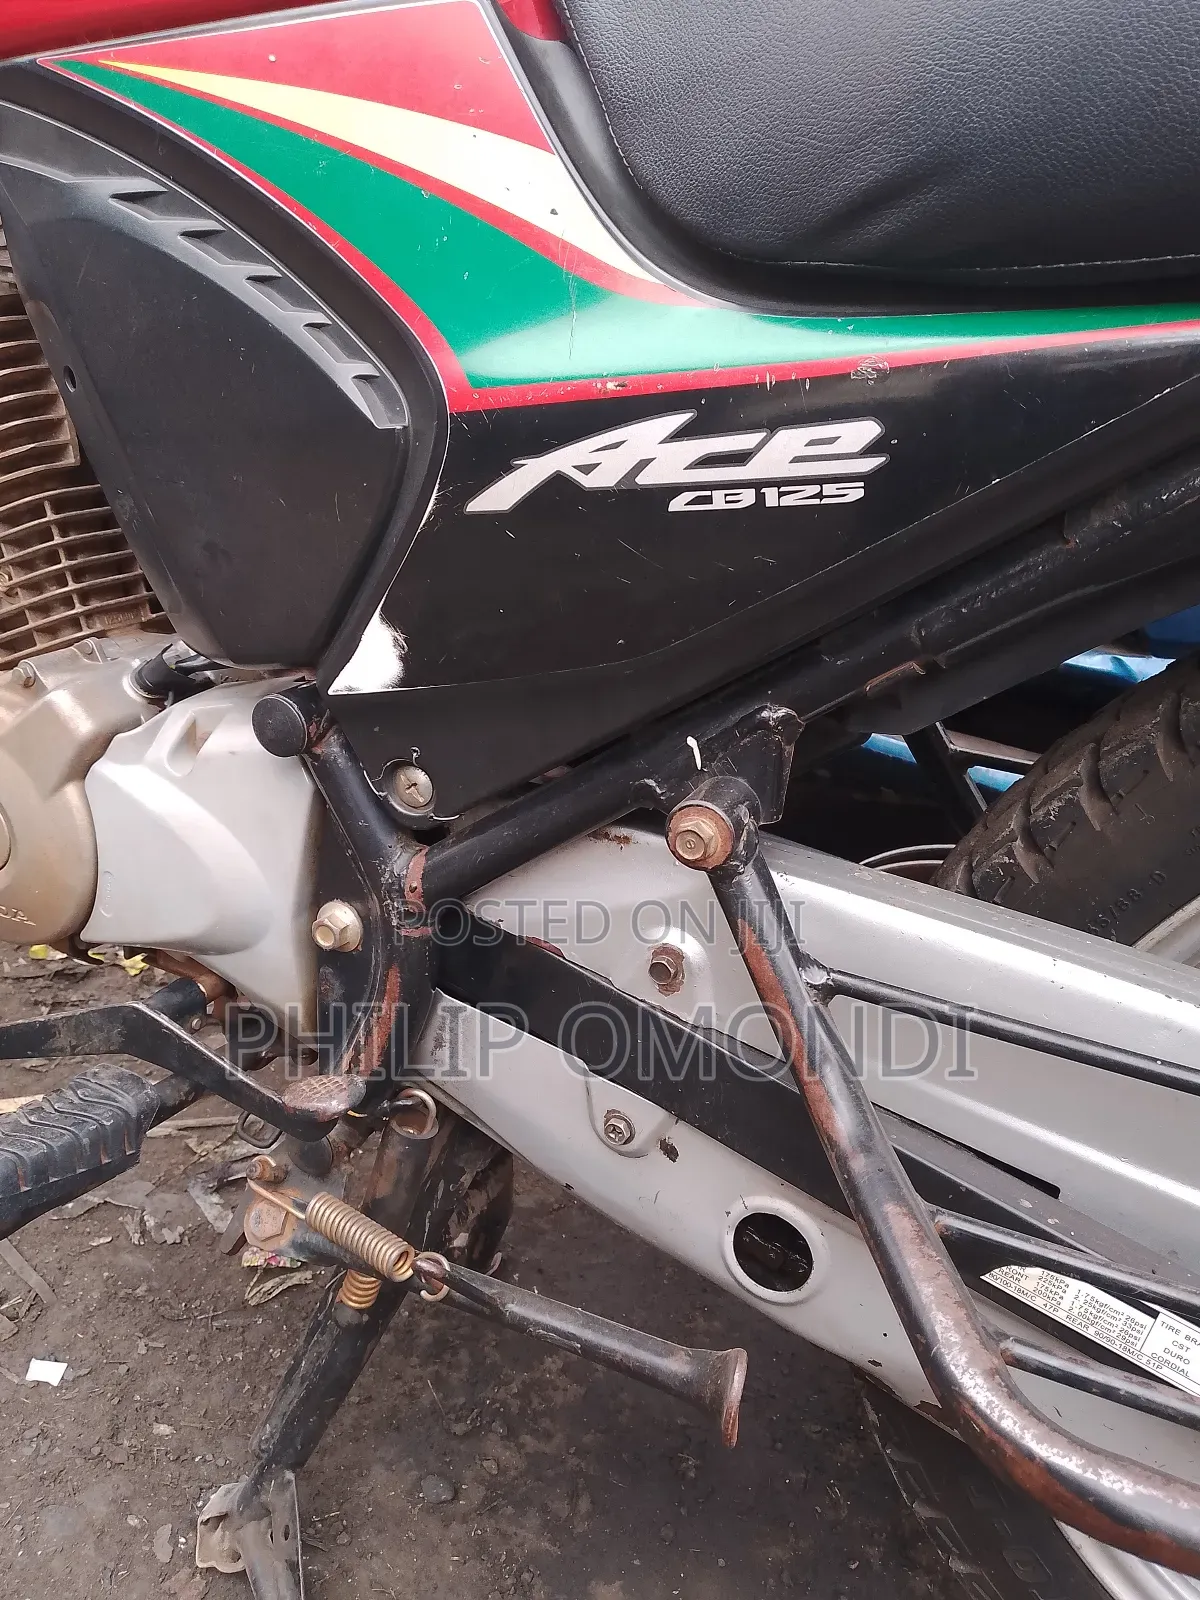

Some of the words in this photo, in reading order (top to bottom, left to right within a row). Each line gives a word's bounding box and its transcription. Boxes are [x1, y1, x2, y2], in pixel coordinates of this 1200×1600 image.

[464, 408, 889, 513] Ace
[999, 1268, 1021, 1284] REAR
[1006, 1266, 1030, 1281] RONT
[1042, 1302, 1059, 1313] 47P
[1065, 1314, 1090, 1332] REAR
[1145, 1359, 1163, 1370] 51P
[1160, 1320, 1182, 1336] TIRE
[1171, 1340, 1191, 1353] CST
[1163, 1347, 1191, 1365] DURO
[1150, 1352, 1190, 1378] CORDIAL
